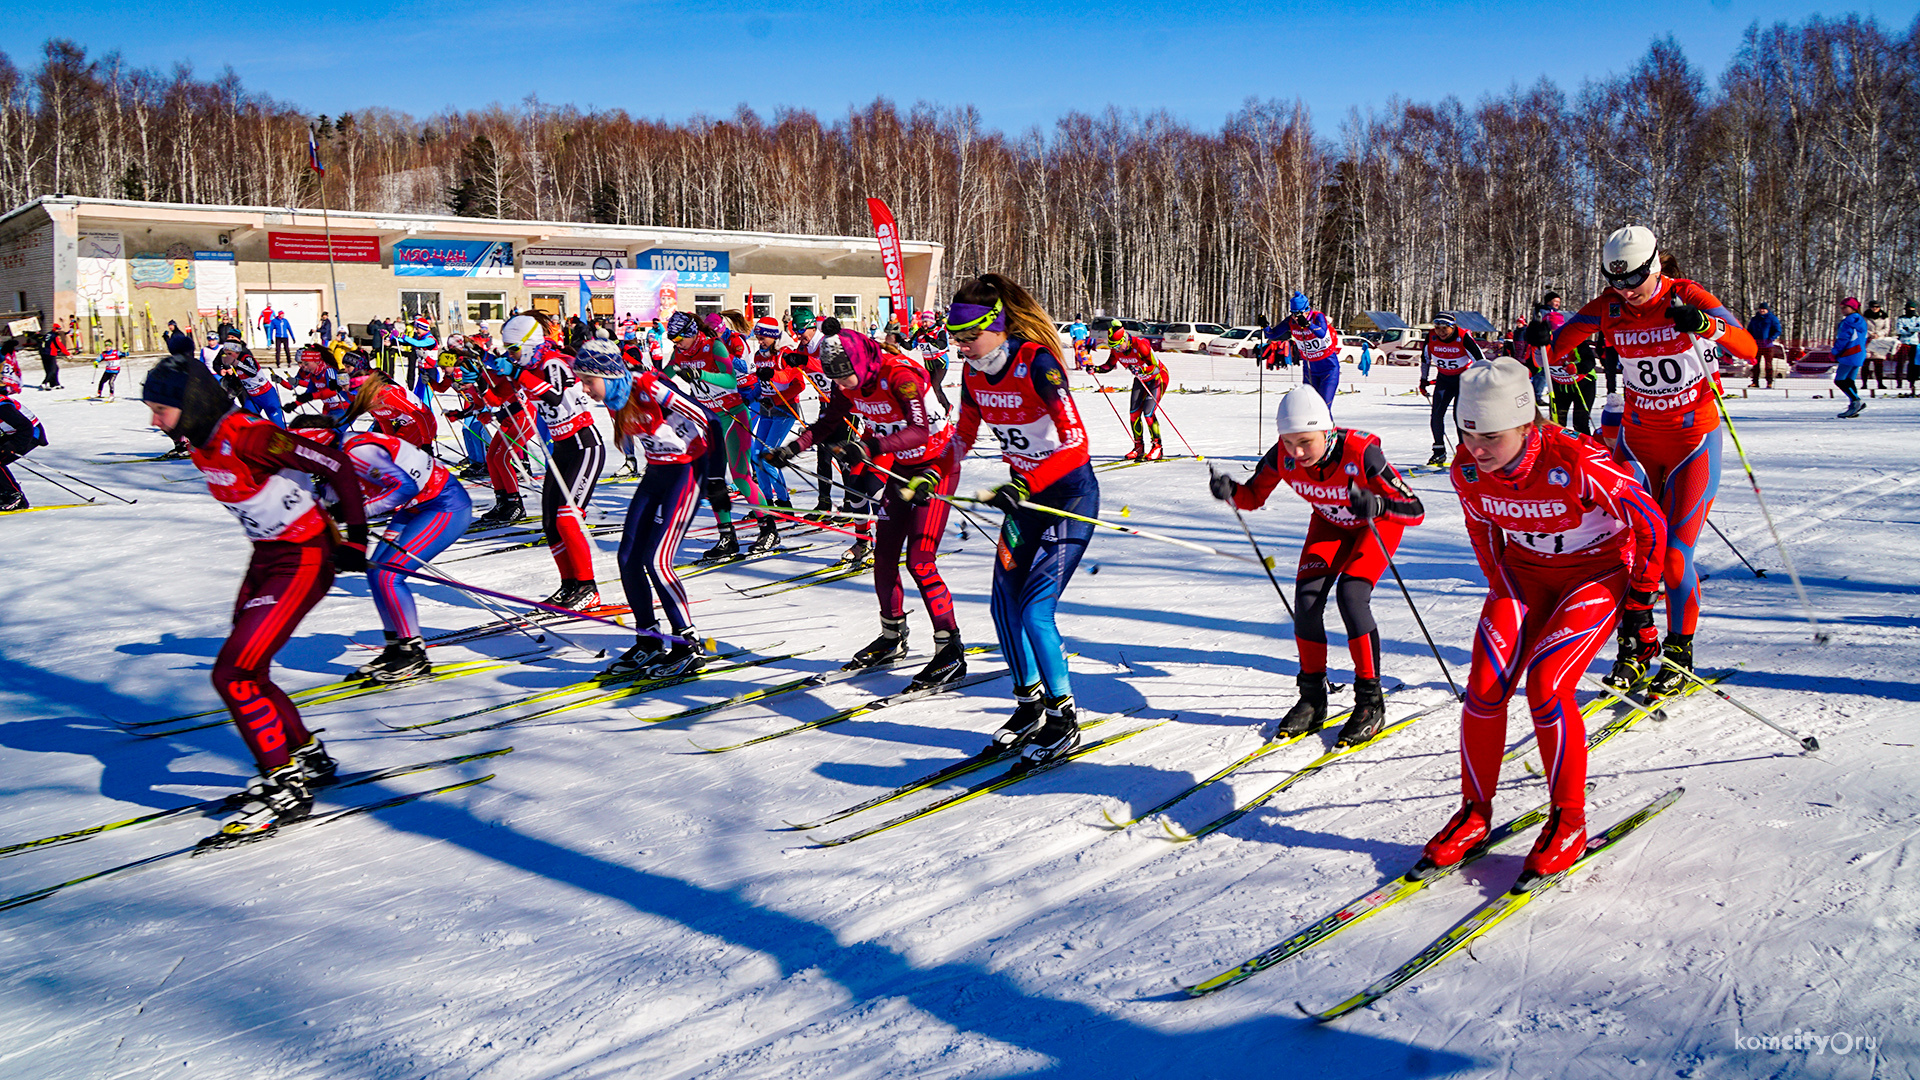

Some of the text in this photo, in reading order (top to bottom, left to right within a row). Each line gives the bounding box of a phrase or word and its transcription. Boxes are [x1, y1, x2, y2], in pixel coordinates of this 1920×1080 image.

[399, 248, 467, 263] МЯО-ЧАН
[650, 255, 718, 271] ПИОНЕР
[1614, 328, 1681, 346] ПИОНЕР
[1704, 346, 1718, 363] 80
[1436, 359, 1459, 370] 85
[1637, 358, 1682, 387] 80
[854, 400, 892, 415] ПИОНЕР
[1635, 389, 1698, 411] ПИОНЕР
[550, 423, 574, 436] ОНЕР
[896, 446, 926, 459] ОНЕР
[1291, 481, 1350, 500] ПИОНЕ
[1481, 497, 1567, 518] ПИОНЕР
[914, 561, 954, 618] RUS
[1534, 627, 1574, 652] RUSSIA
[228, 680, 287, 753] RUS
